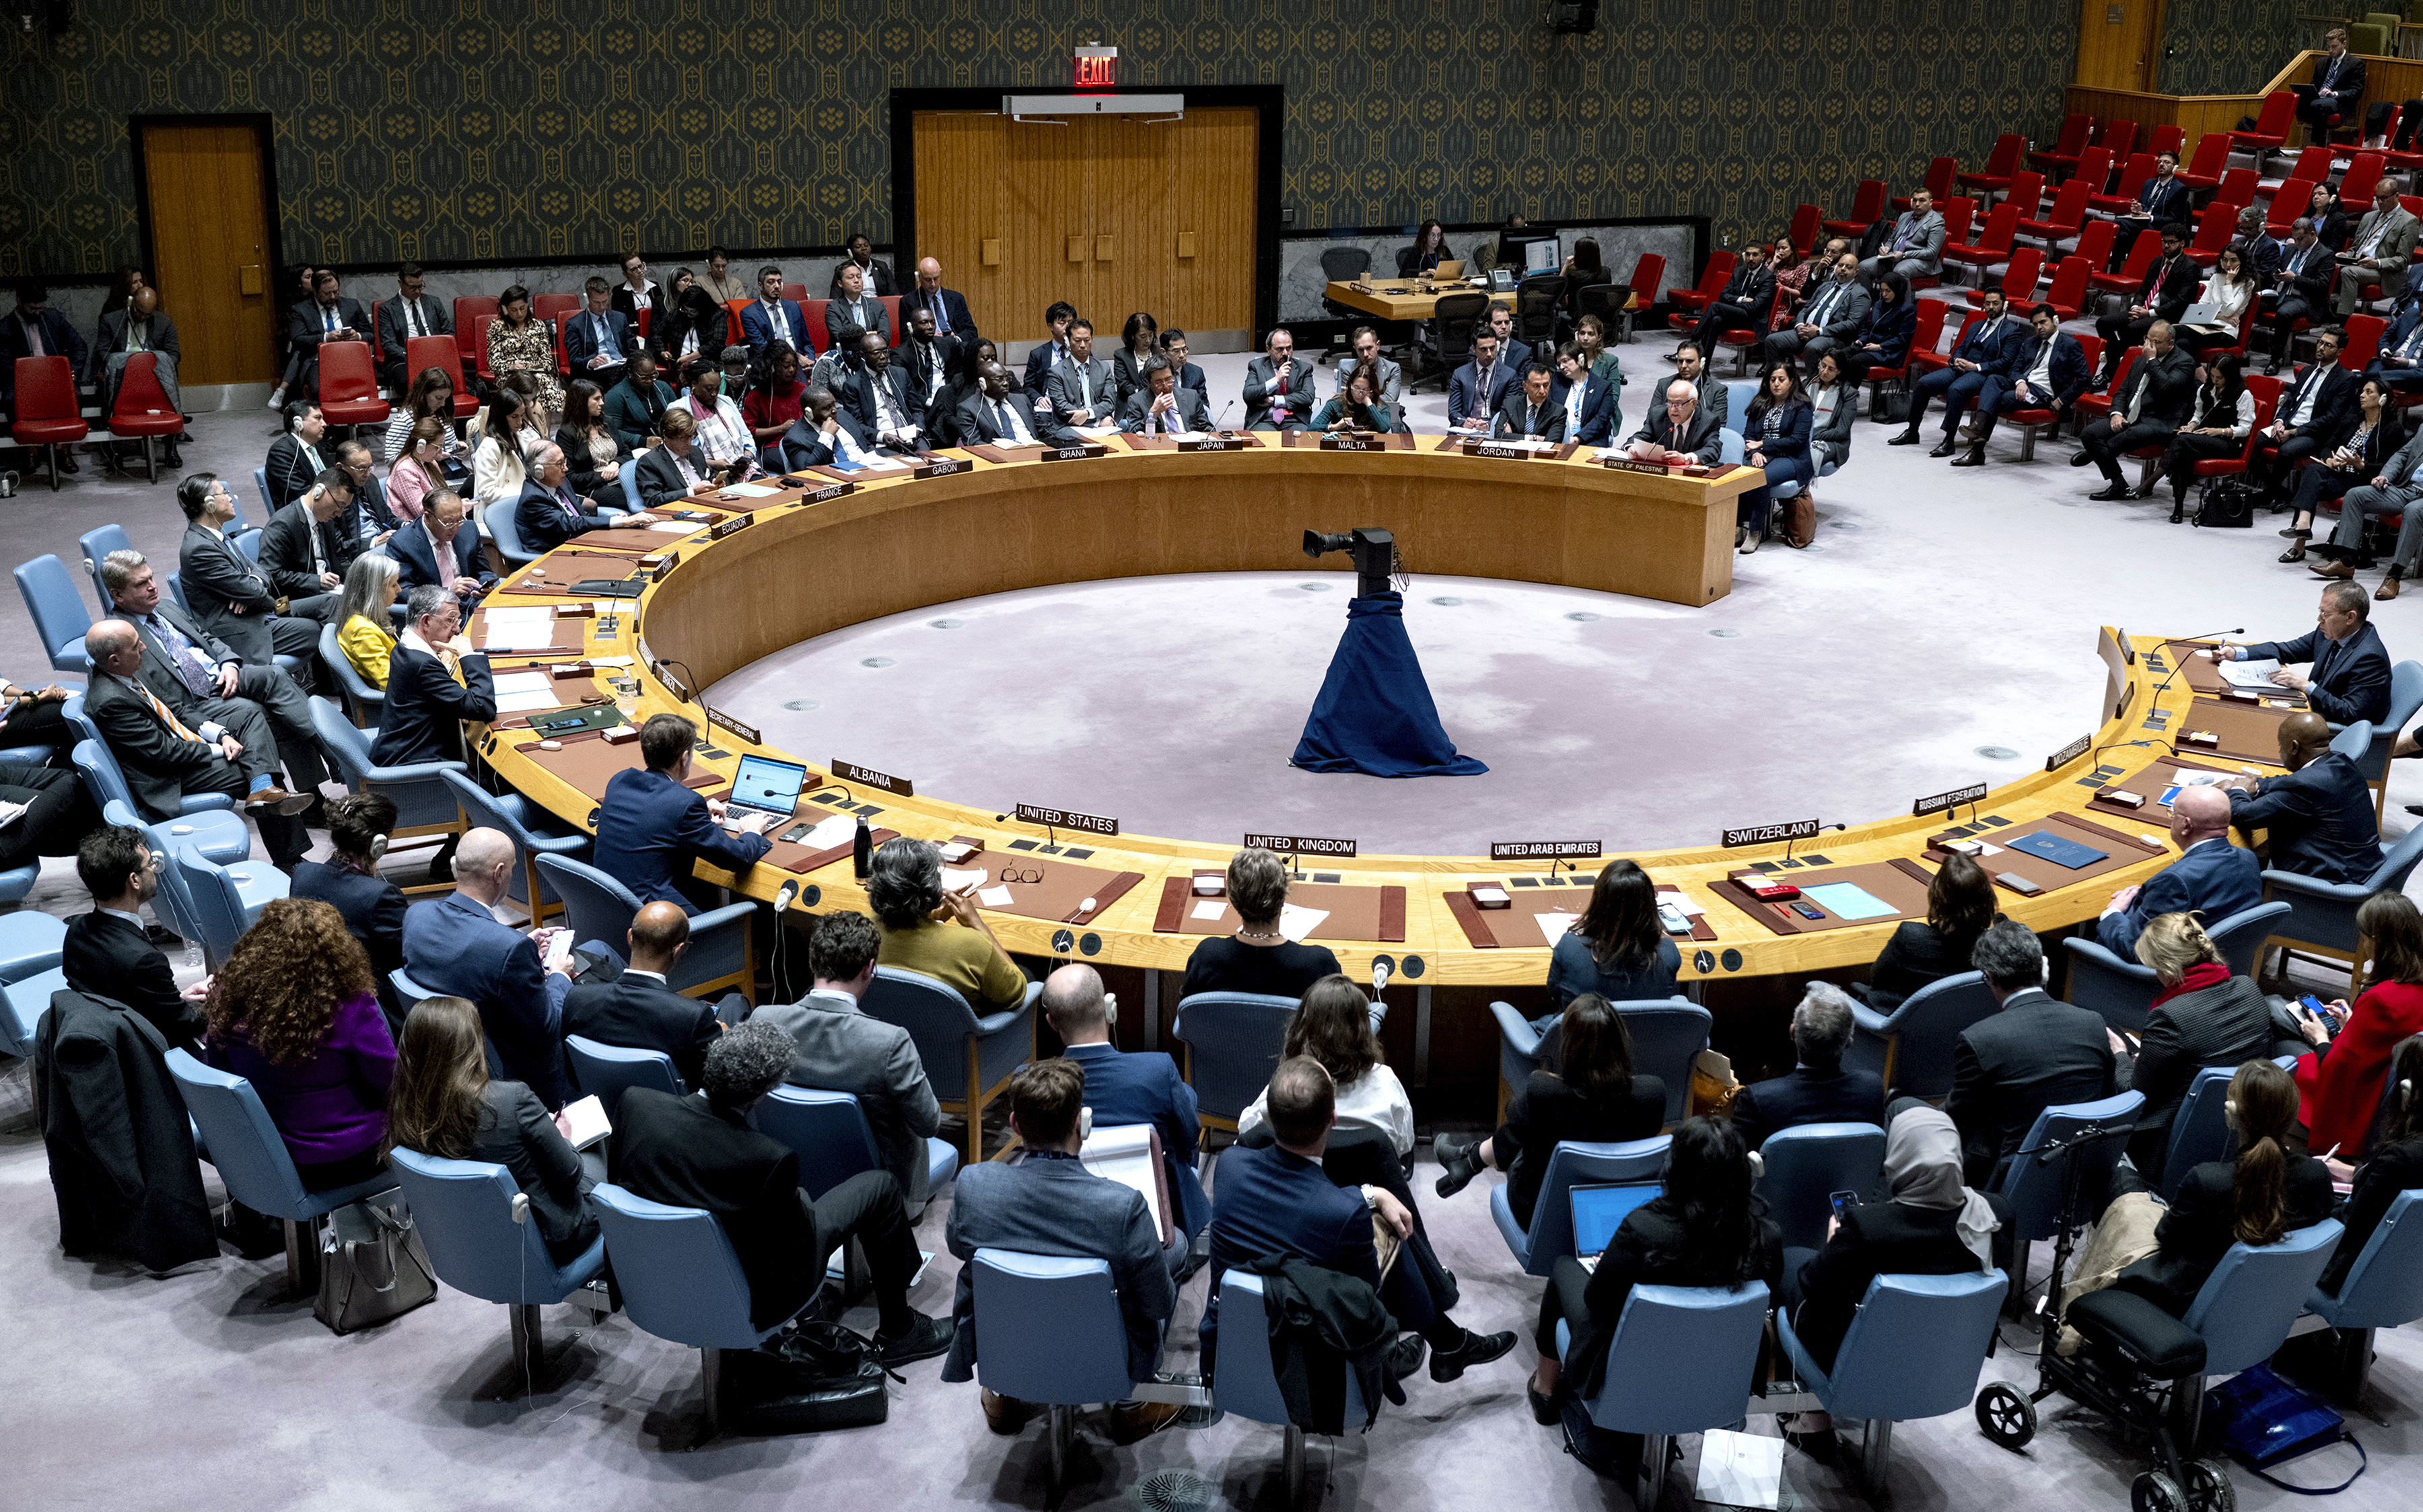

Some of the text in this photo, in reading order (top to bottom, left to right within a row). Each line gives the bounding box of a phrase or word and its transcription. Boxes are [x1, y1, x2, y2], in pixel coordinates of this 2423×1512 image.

[1081, 57, 1111, 82] EXIT
[1197, 441, 1224, 450] JAPAN
[1338, 441, 1366, 449] MALTA
[1477, 447, 1514, 457] JORDAN
[1059, 449, 1086, 459] GHANA
[932, 464, 956, 475] GABON
[1607, 460, 1623, 468] STATE
[1635, 464, 1664, 473] PALESTINE
[816, 486, 843, 500] FRANCE
[722, 517, 746, 534] ECUADOR
[662, 559, 673, 574] CHINA
[662, 672, 676, 694] BRAZIL
[708, 709, 755, 741] SECRETARY-GENERAL
[2053, 741, 2088, 767] MOZAMBIQUE
[849, 766, 892, 788] ALBANIA
[1918, 785, 1986, 811] RUSSIAN FEDERATION
[1019, 805, 1114, 832] UNITED STATES
[1727, 822, 1816, 844] SWITZERLAND
[1247, 836, 1354, 853] UNITED KINGDOM
[1494, 843, 1599, 855] UNITED ARAB EMIRATES
